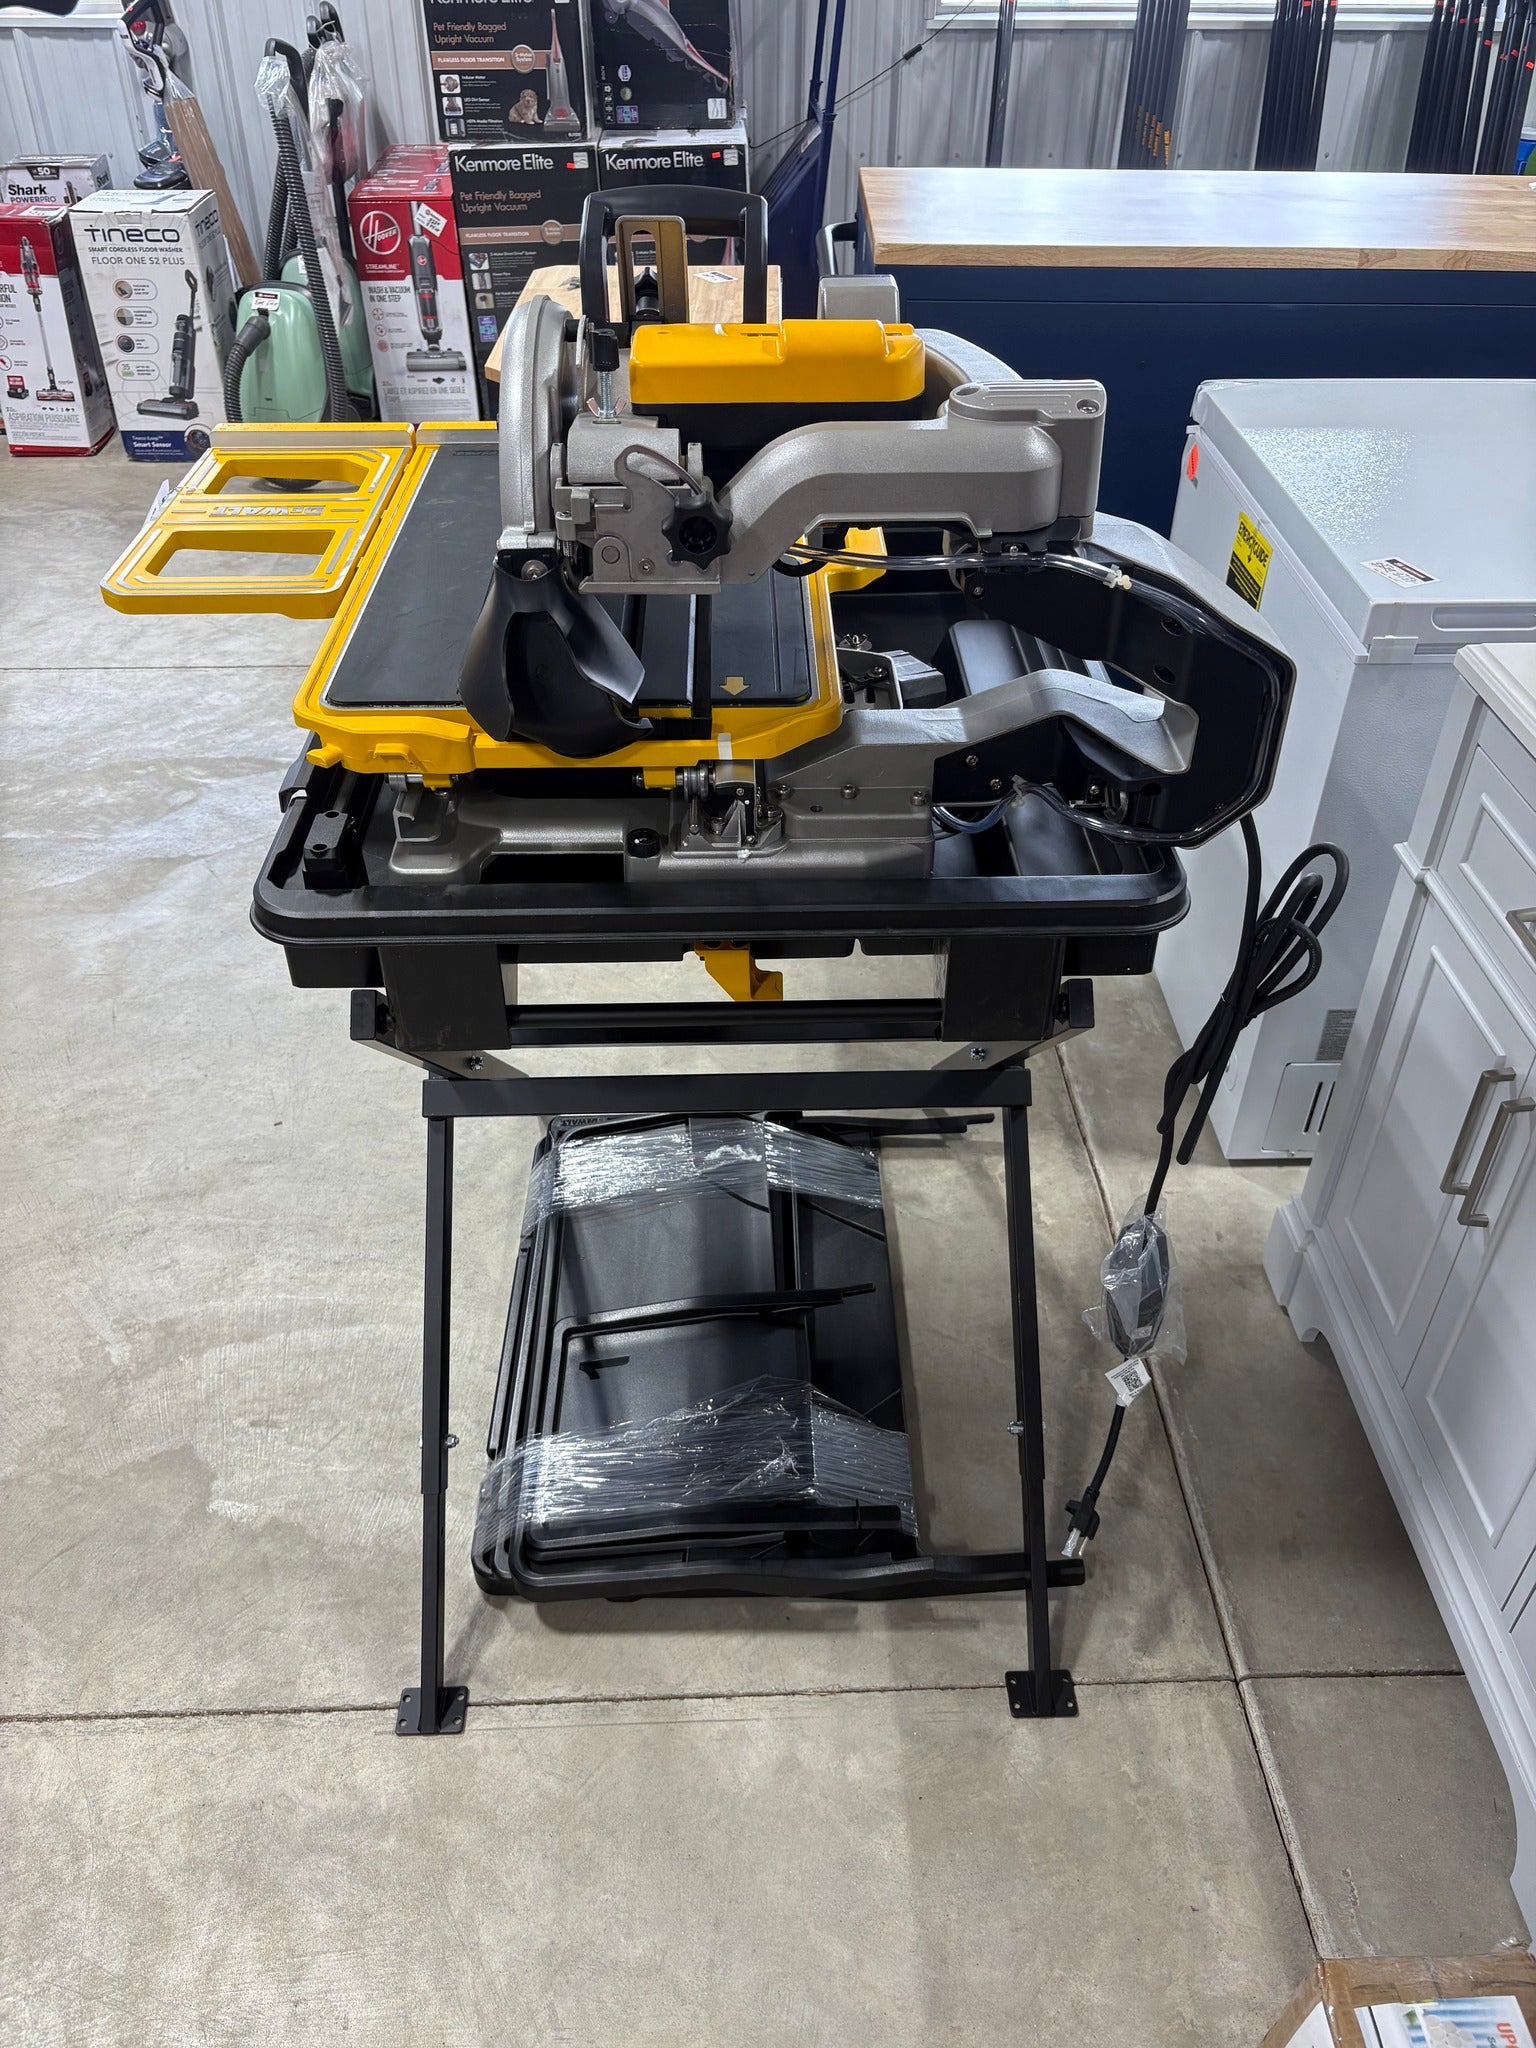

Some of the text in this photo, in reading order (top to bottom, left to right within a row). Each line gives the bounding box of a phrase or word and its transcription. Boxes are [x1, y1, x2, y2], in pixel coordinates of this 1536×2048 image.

[433, 21, 507, 32] Pet Friendly Bagged
[434, 34, 495, 45] Upright Vacuum
[455, 153, 554, 172] Kenmore Elite
[605, 151, 704, 171] Kenmore Elite
[37, 167, 50, 175] 50
[8, 184, 47, 195] Shark
[460, 189, 541, 202] Pet Friendly Bagged
[461, 202, 528, 214] Upright Vacuum
[91, 256, 122, 265] FLOOR
[126, 256, 147, 265] ONE
[163, 256, 186, 265] PLUS
